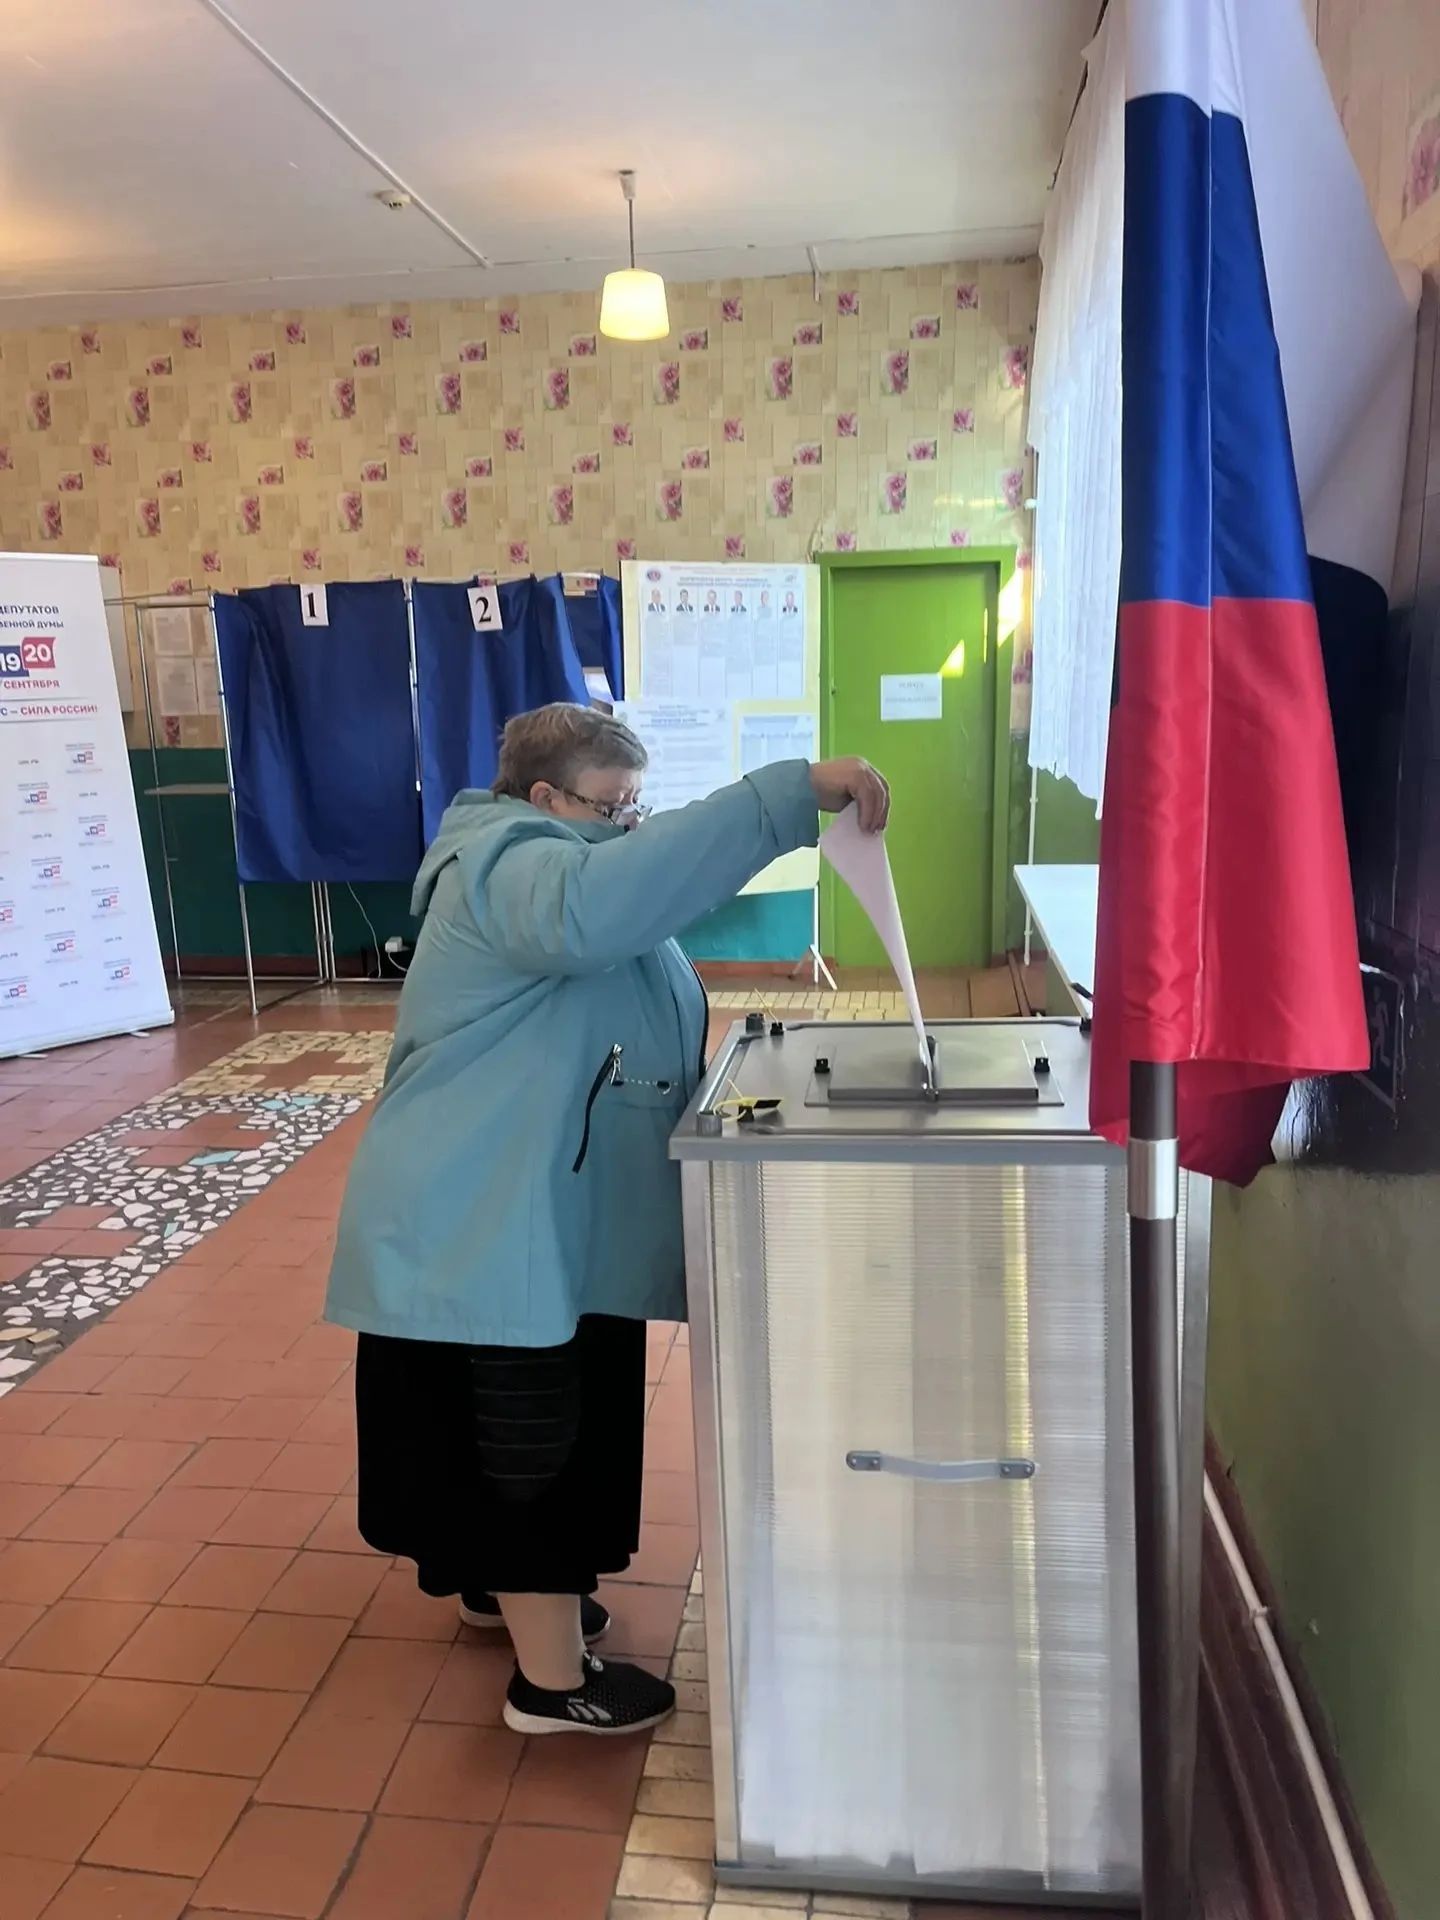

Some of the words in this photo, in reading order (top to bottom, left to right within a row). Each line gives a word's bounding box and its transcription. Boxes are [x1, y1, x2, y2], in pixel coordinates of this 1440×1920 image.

[304, 592, 317, 618] 1
[475, 596, 492, 623] 2
[37, 621, 64, 629] ДУМЫ
[0, 652, 20, 672] 19
[23, 643, 52, 662] 20
[3, 680, 60, 689] СЕНТЯБРЯ
[20, 705, 50, 715] СИЛА
[52, 704, 98, 714] РОССИИ!
